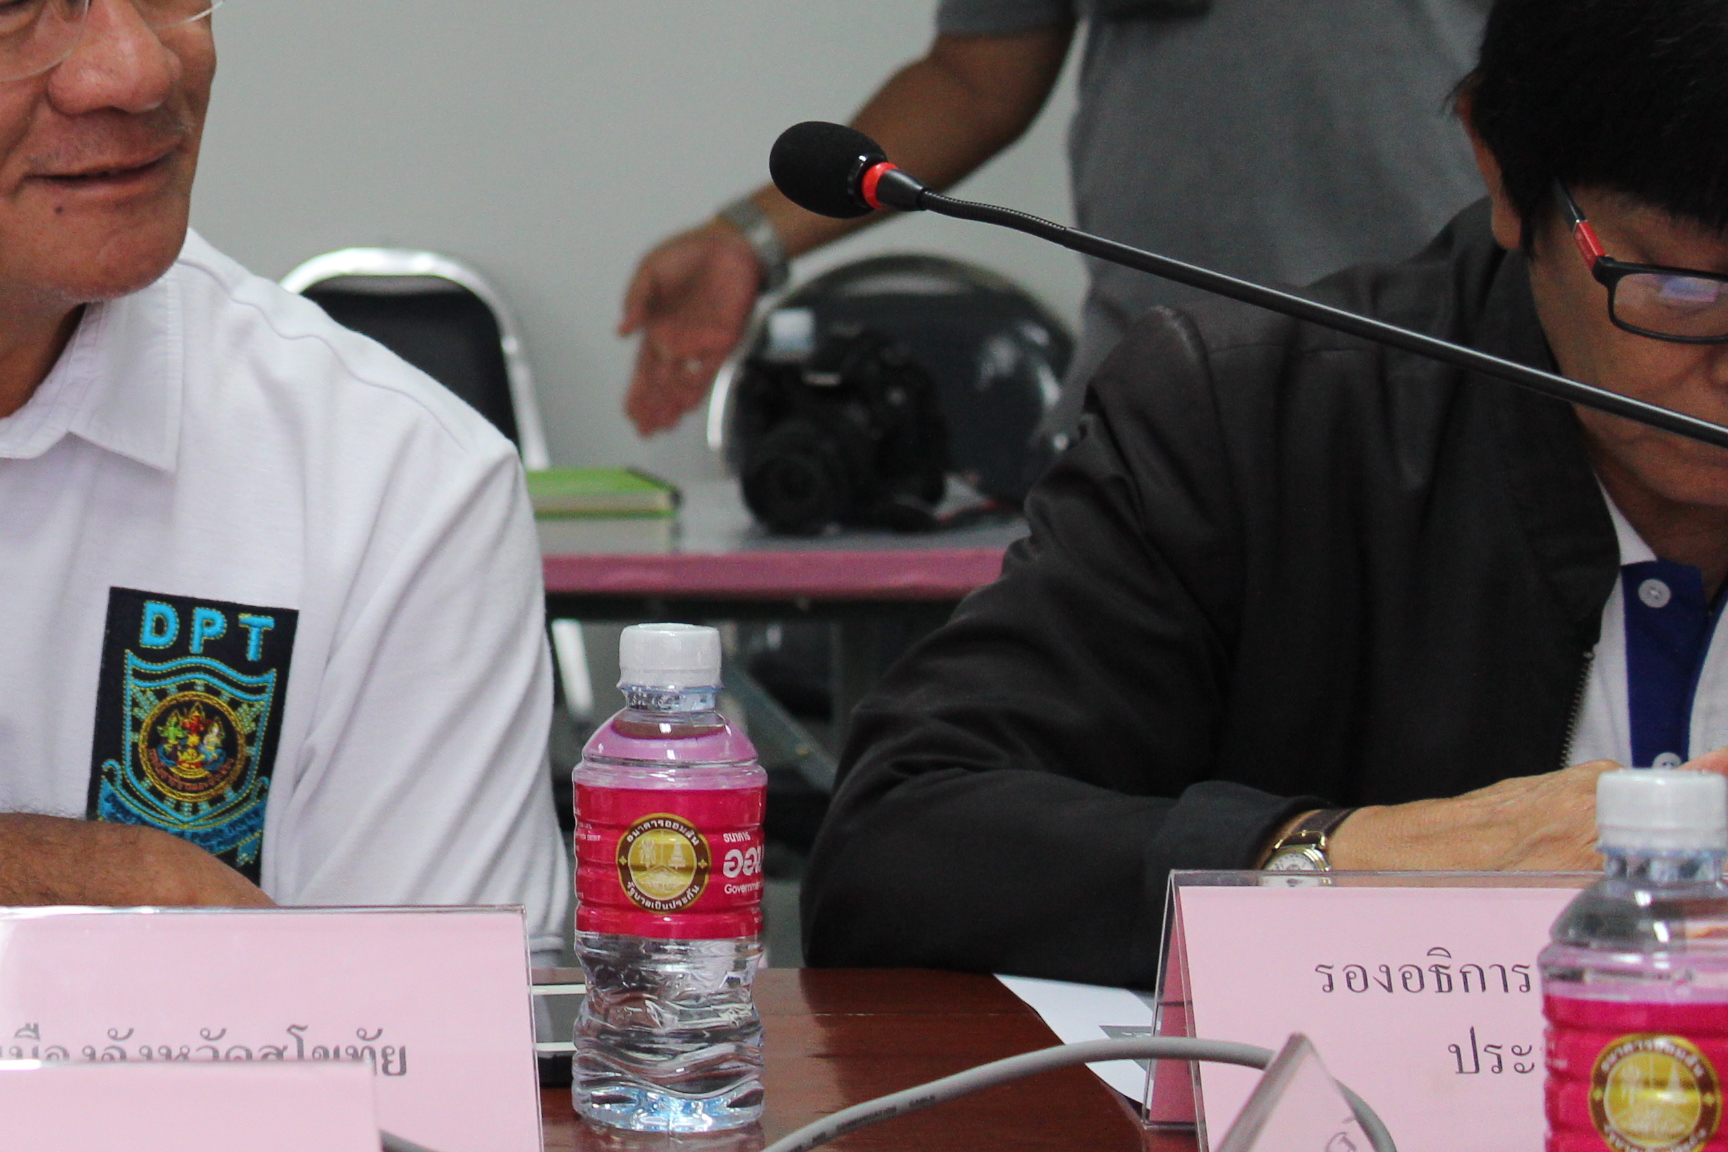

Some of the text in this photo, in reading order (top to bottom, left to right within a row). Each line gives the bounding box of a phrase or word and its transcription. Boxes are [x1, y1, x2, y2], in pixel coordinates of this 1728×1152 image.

[138, 600, 275, 662] DPT
[1314, 946, 1532, 994] รองอธิการ
[1447, 1025, 1535, 1074] ประ
